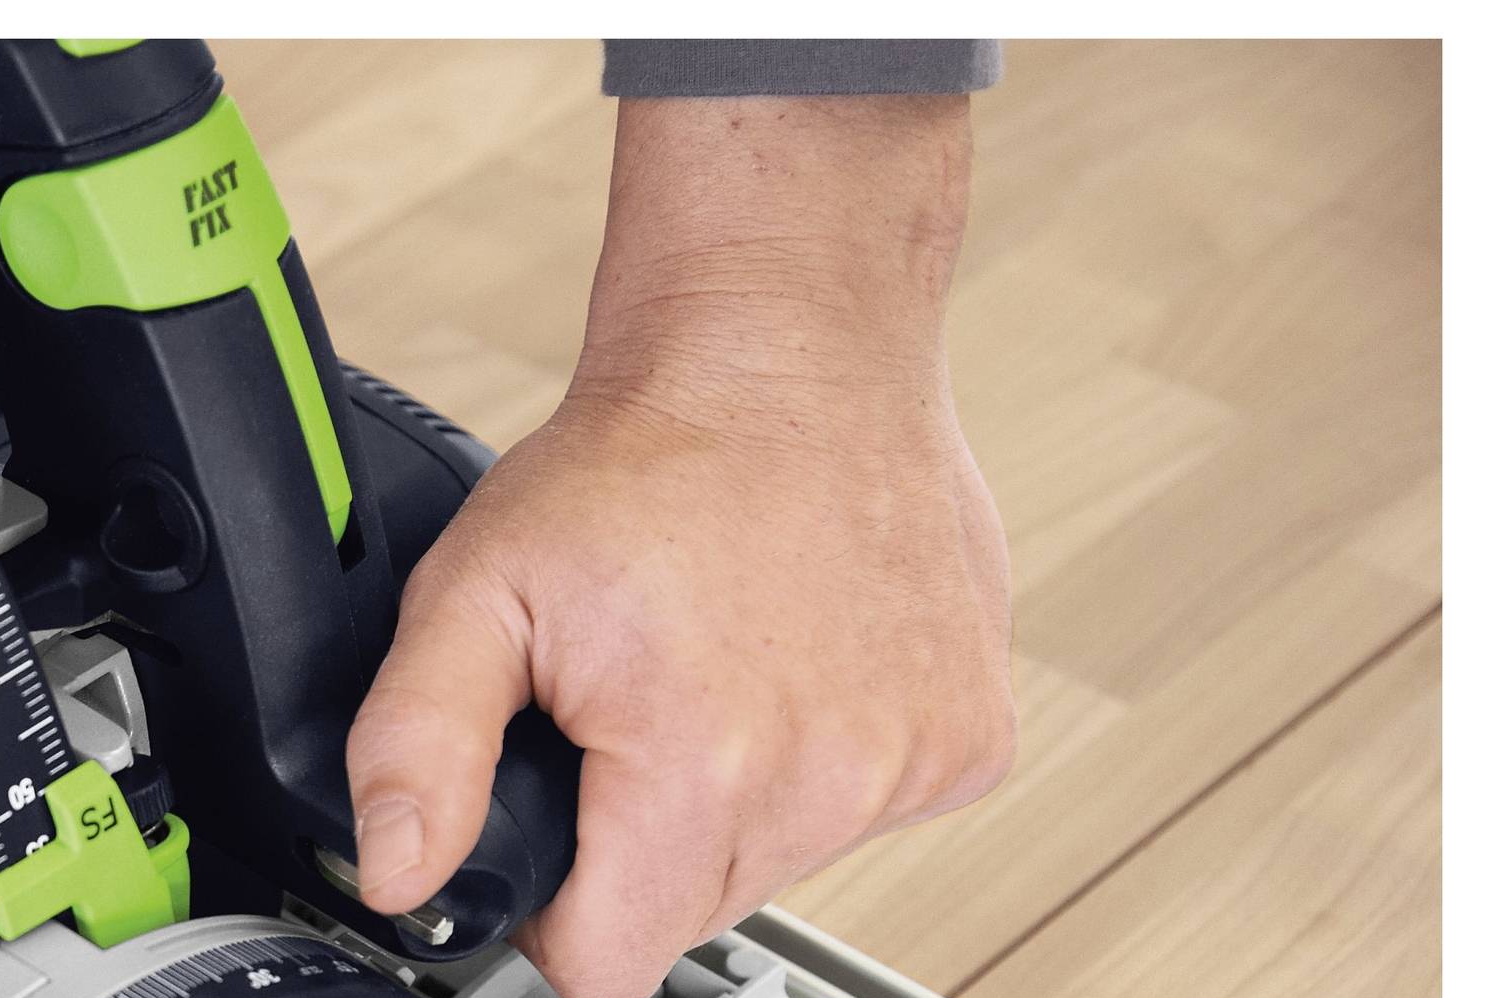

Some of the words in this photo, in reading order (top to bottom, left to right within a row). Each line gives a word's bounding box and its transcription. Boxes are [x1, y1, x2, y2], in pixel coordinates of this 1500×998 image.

[183, 159, 238, 213] FAST
[190, 203, 232, 248] FIX
[8, 777, 36, 811] 50
[81, 797, 118, 840] FS
